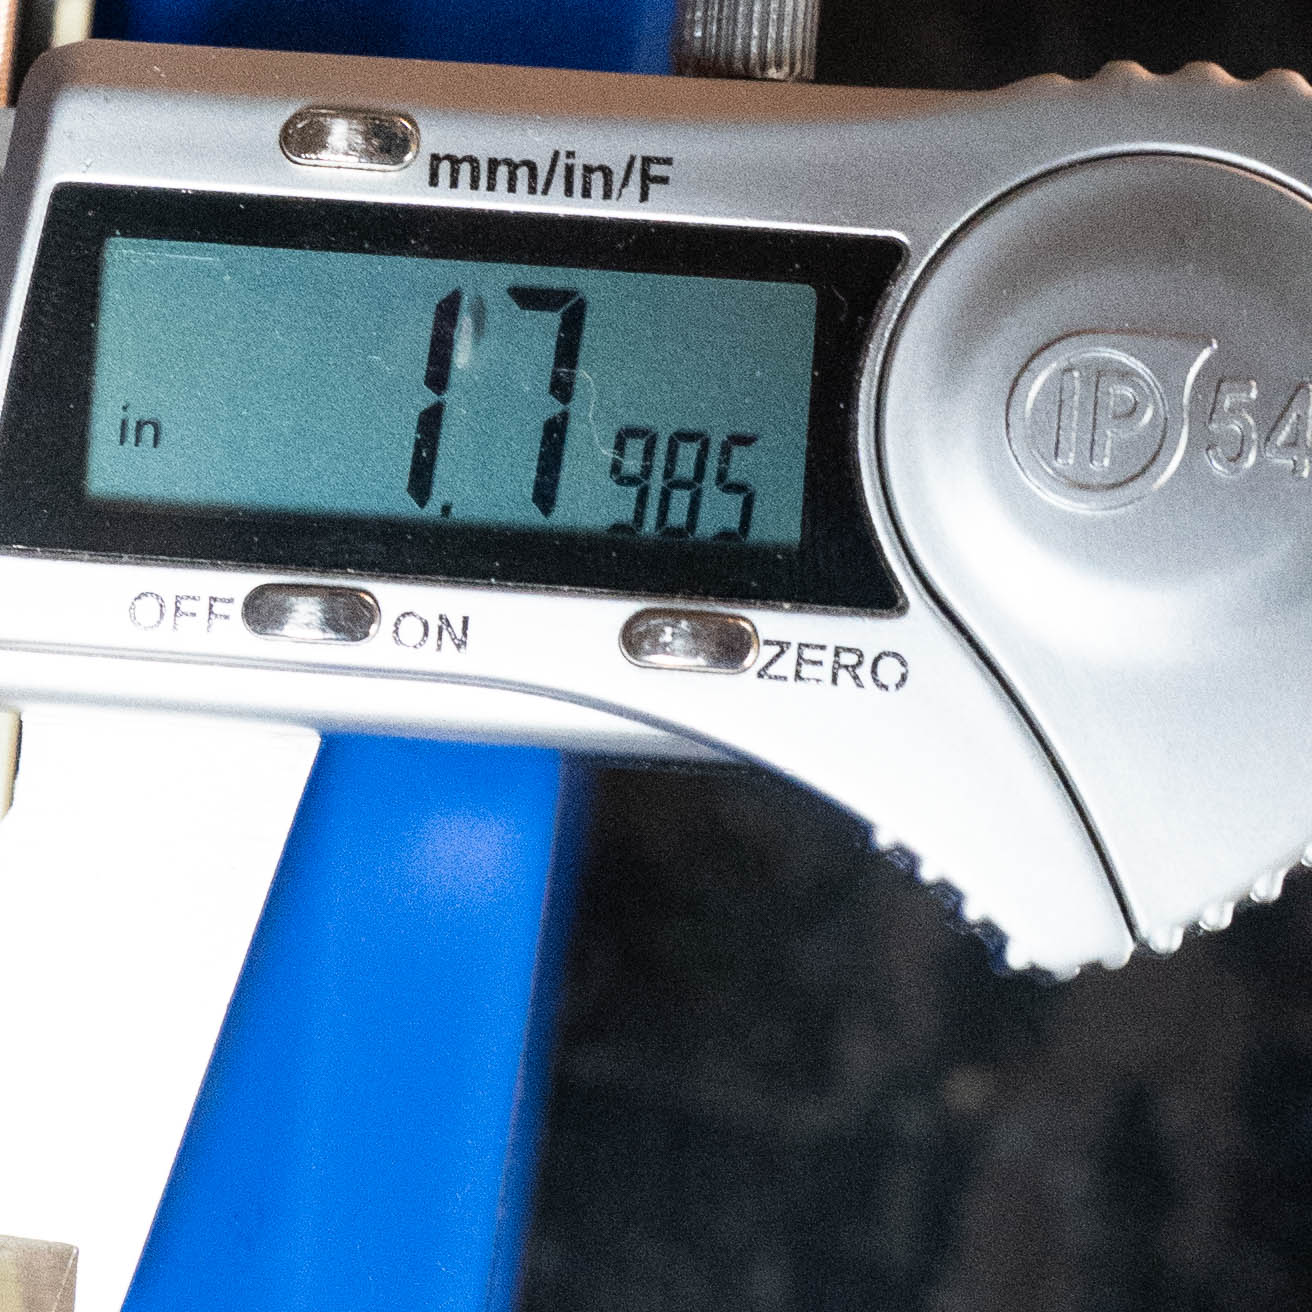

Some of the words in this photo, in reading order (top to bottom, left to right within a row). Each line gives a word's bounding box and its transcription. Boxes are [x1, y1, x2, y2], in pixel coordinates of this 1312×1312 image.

[426, 149, 674, 204] mm/in/F
[117, 405, 163, 452] in
[127, 590, 235, 634] OFF
[391, 609, 471, 656] ON
[755, 639, 912, 694] ZERO
